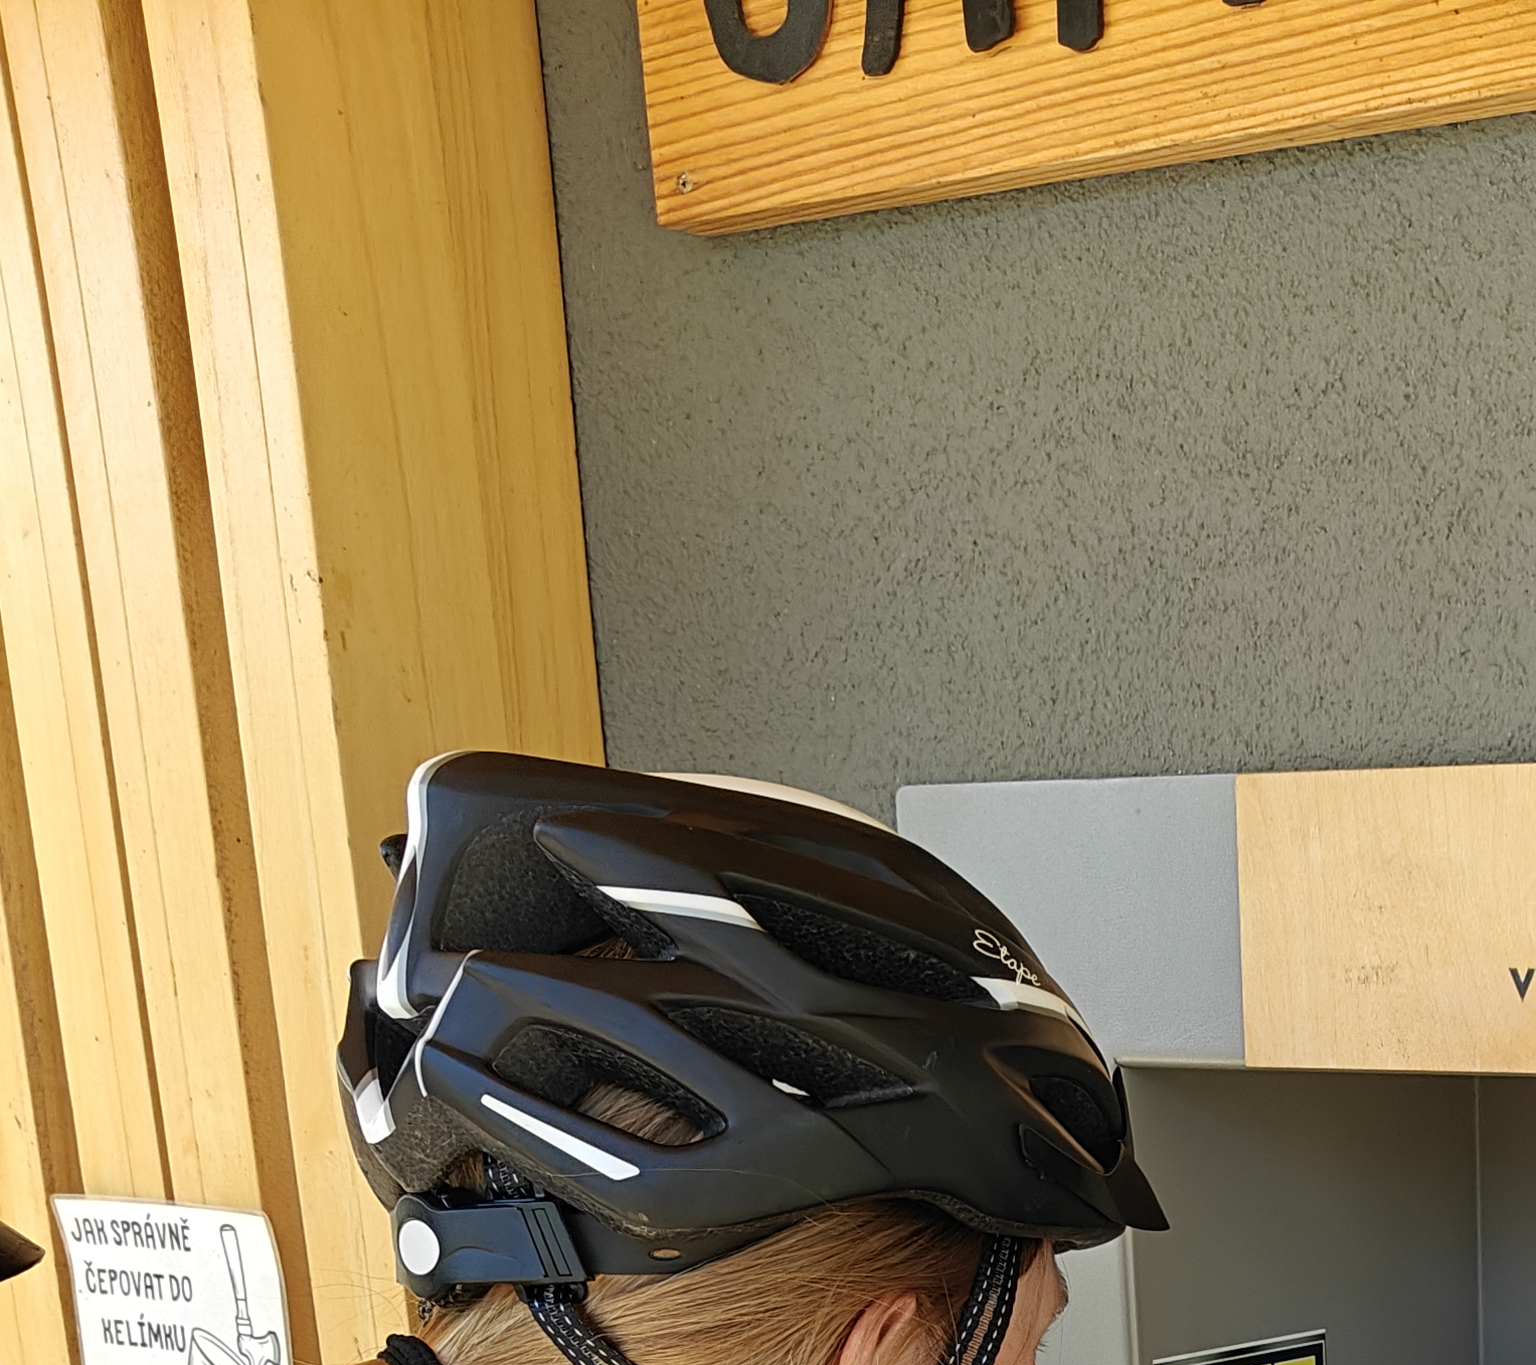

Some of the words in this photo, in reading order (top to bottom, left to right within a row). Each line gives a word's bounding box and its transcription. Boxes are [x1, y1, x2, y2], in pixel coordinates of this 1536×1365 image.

[973, 929, 1041, 986] Etape
[71, 1217, 106, 1245] JAK
[112, 1213, 192, 1252] SPRÁVNĚ
[84, 1260, 165, 1300] ČEPOVAT
[169, 1276, 193, 1302] DO
[101, 1313, 186, 1353] KELÍMKU
